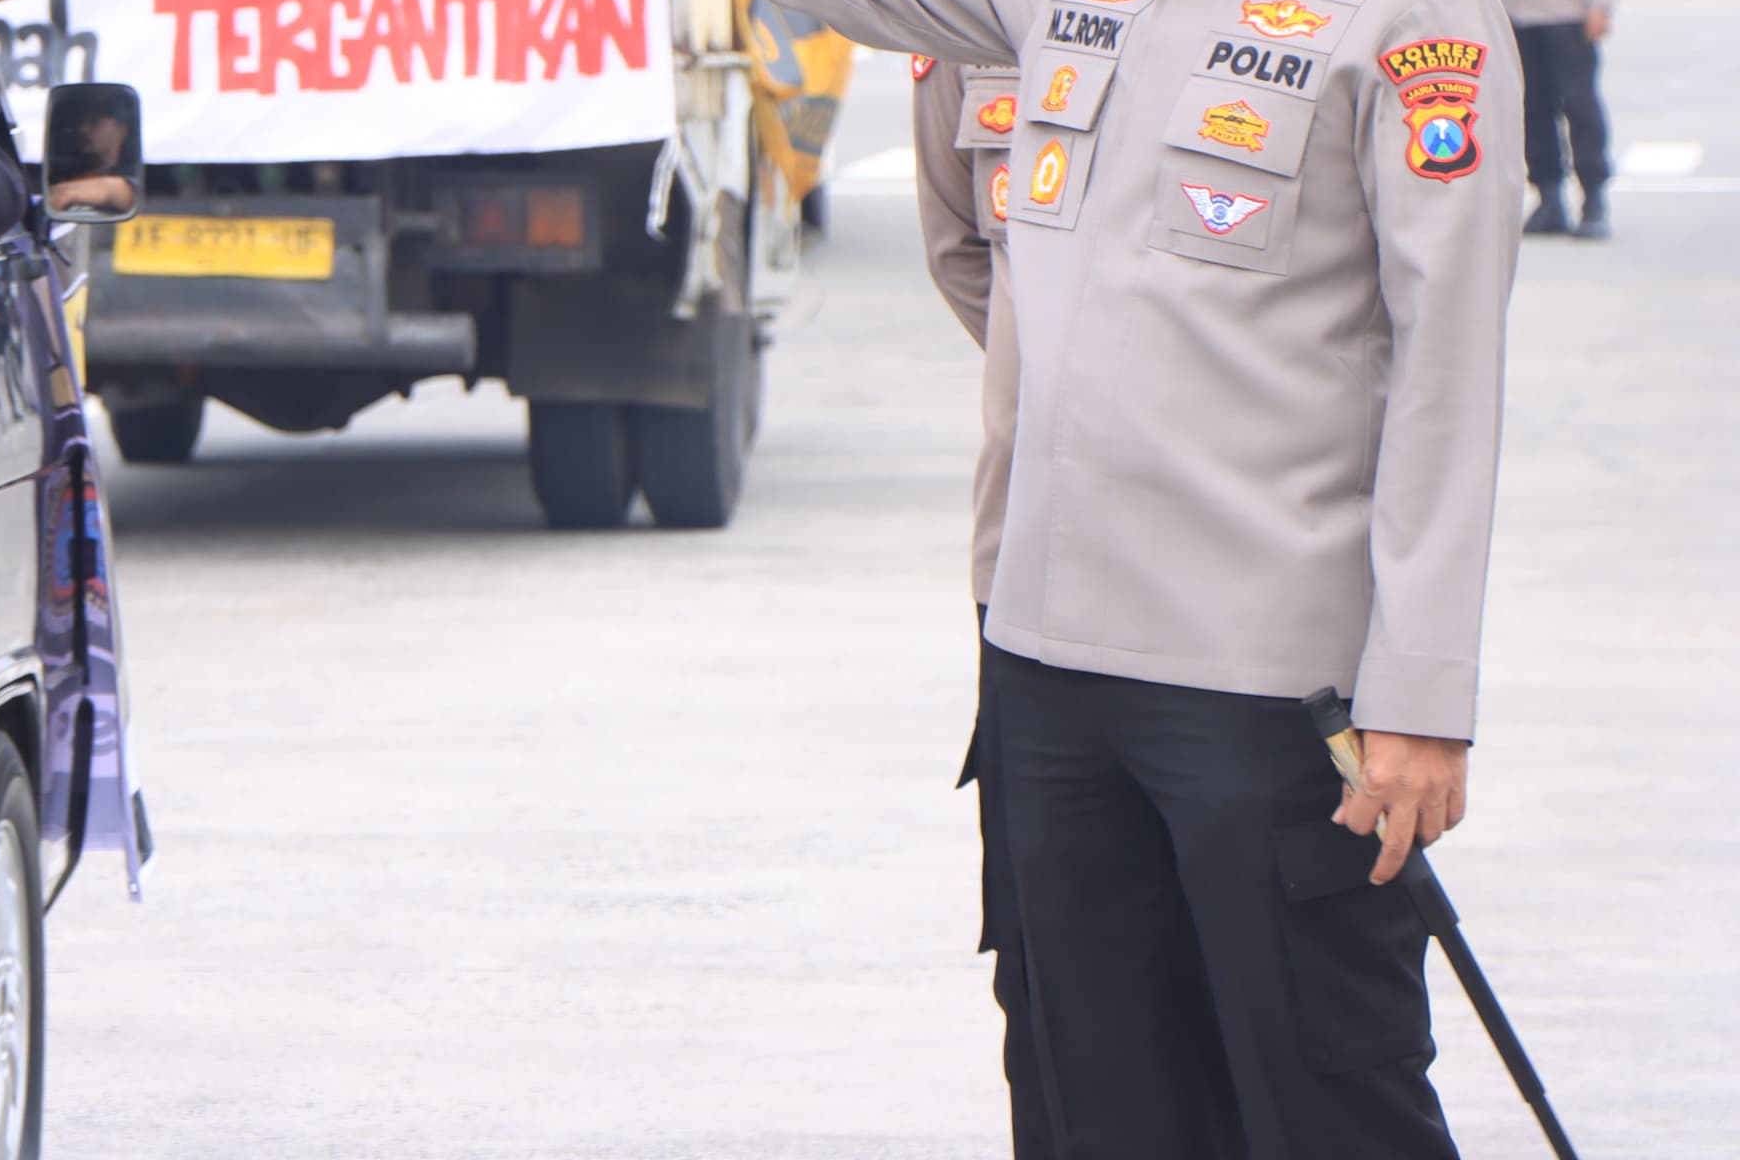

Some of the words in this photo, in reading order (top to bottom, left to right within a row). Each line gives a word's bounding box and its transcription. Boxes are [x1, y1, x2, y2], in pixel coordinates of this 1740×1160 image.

[1206, 40, 1313, 90] POLRI
[1388, 42, 1479, 70] POLRES
[1400, 55, 1473, 77] MADIUN
[1407, 84, 1437, 100] JAWA
[1437, 83, 1474, 96] TIMUR
